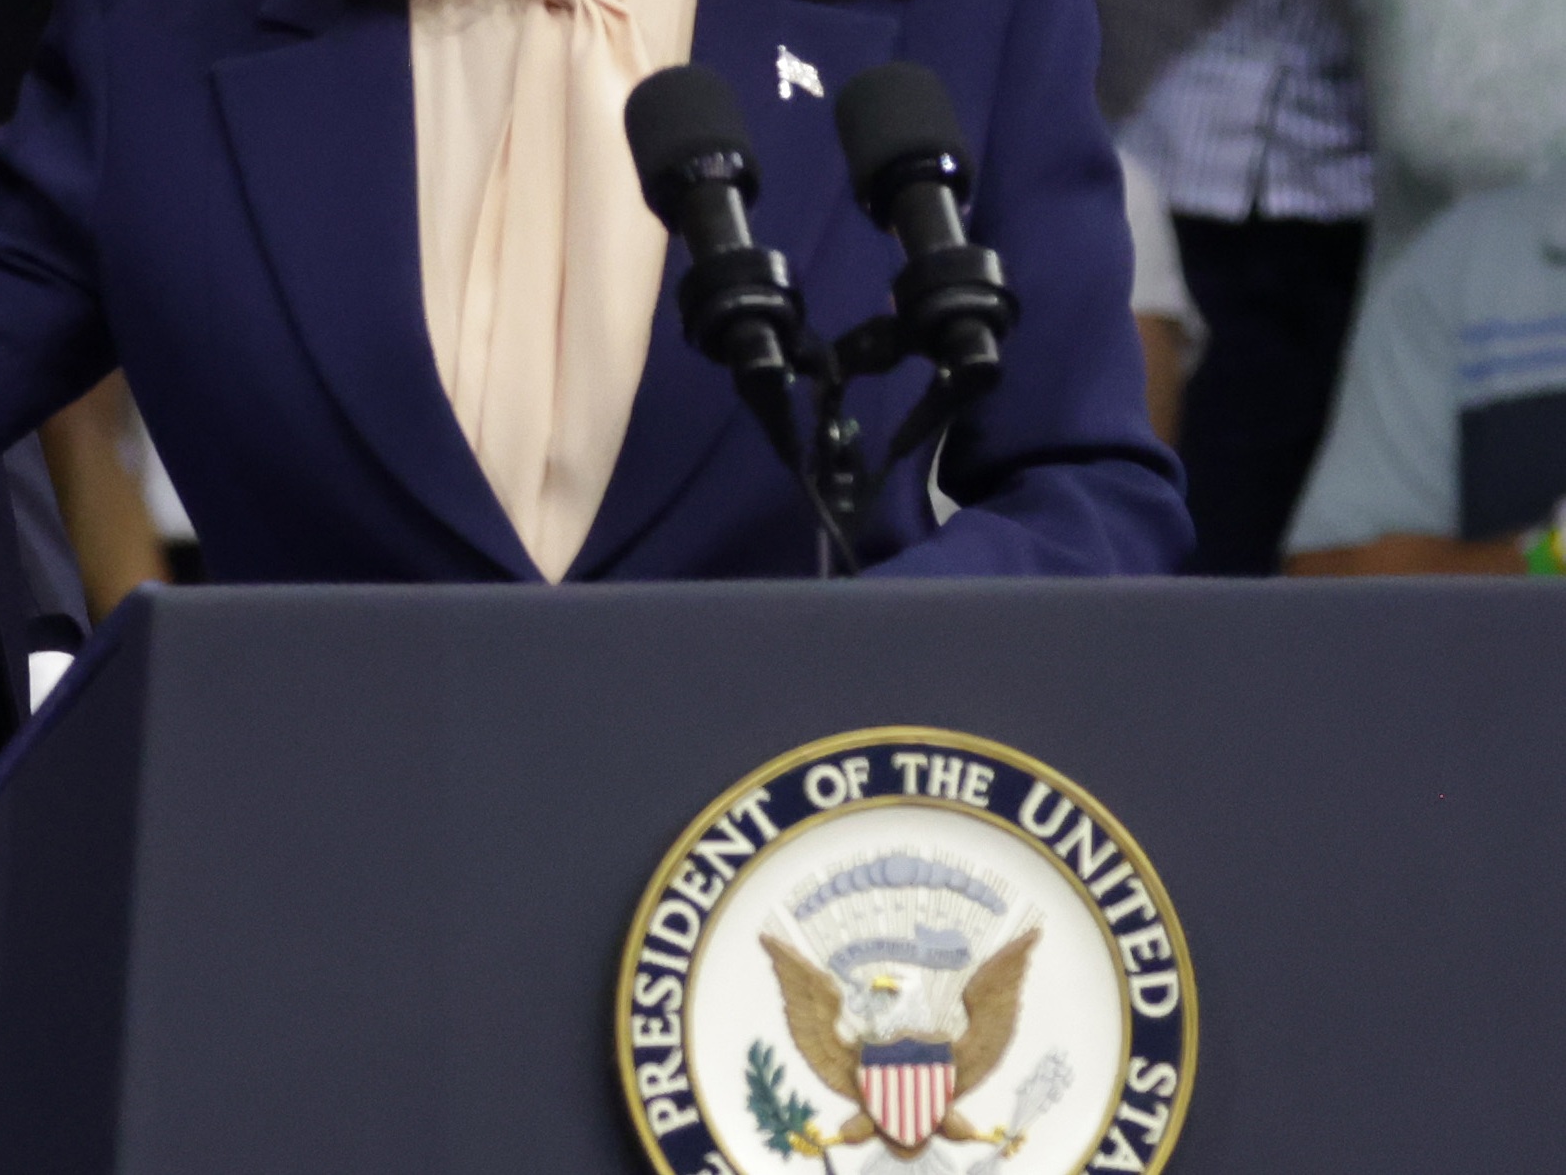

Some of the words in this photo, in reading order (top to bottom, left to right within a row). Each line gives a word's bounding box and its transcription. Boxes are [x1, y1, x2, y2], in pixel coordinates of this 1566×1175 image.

[804, 756, 870, 810] OF
[891, 752, 995, 809] THE
[1017, 780, 1180, 1019] UNITED
[633, 786, 779, 1139] PRESIDENT
[1080, 1056, 1177, 1175] STA
